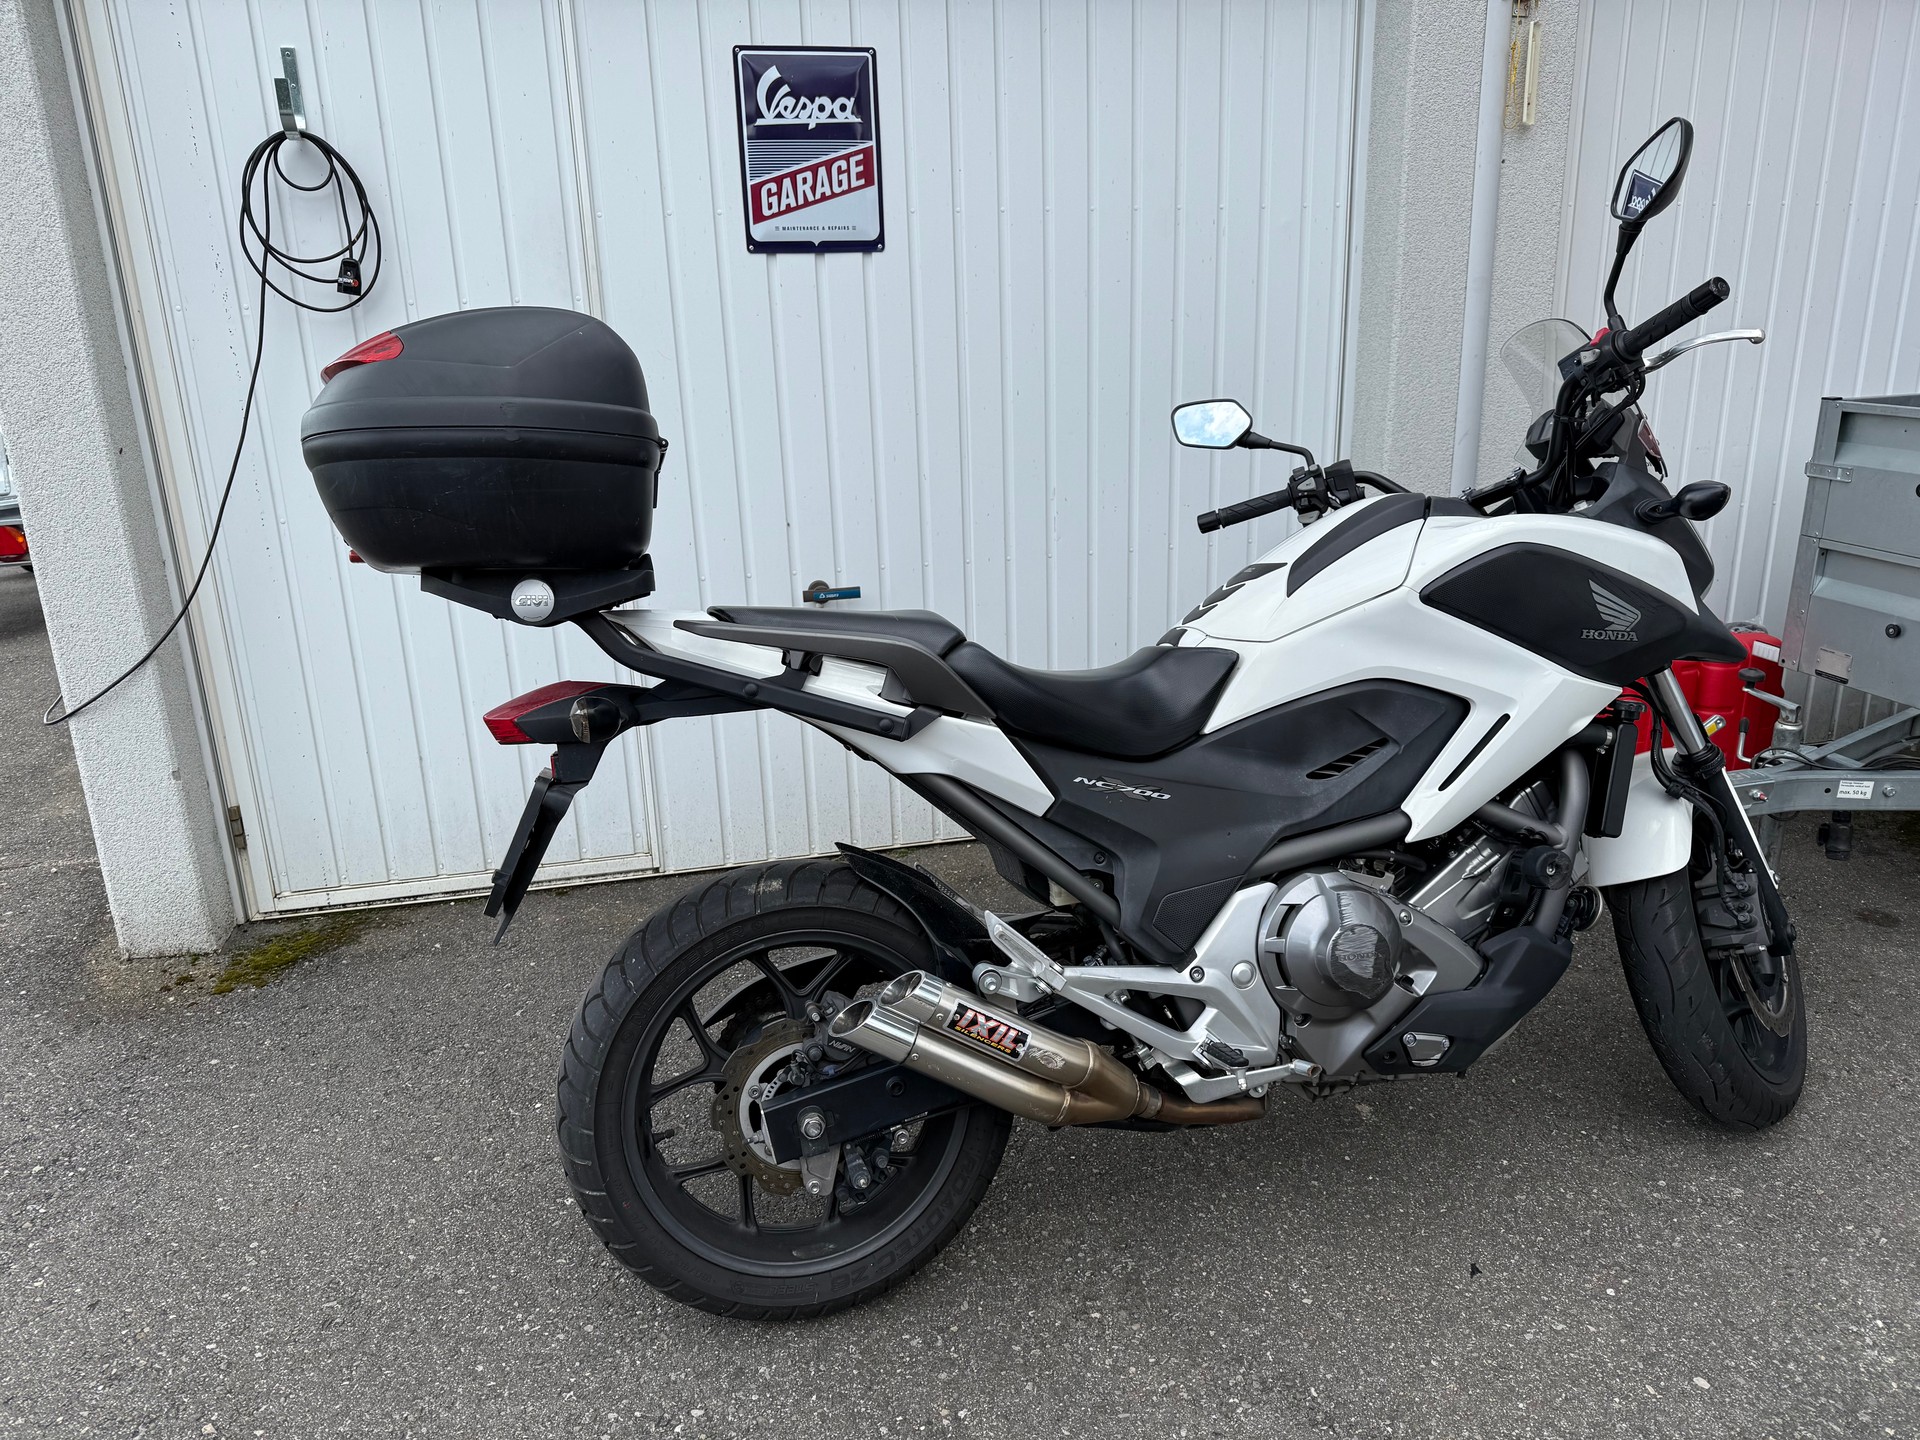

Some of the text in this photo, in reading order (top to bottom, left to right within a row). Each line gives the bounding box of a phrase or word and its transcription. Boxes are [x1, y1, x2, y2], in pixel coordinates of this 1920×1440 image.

[755, 65, 863, 130] Vespa
[760, 153, 866, 217] GARAGE
[515, 595, 548, 607] GIVI
[1580, 629, 1638, 642] HONDA
[954, 1025, 1012, 1054] SILENCERS
[956, 1008, 1019, 1050] IXIL
